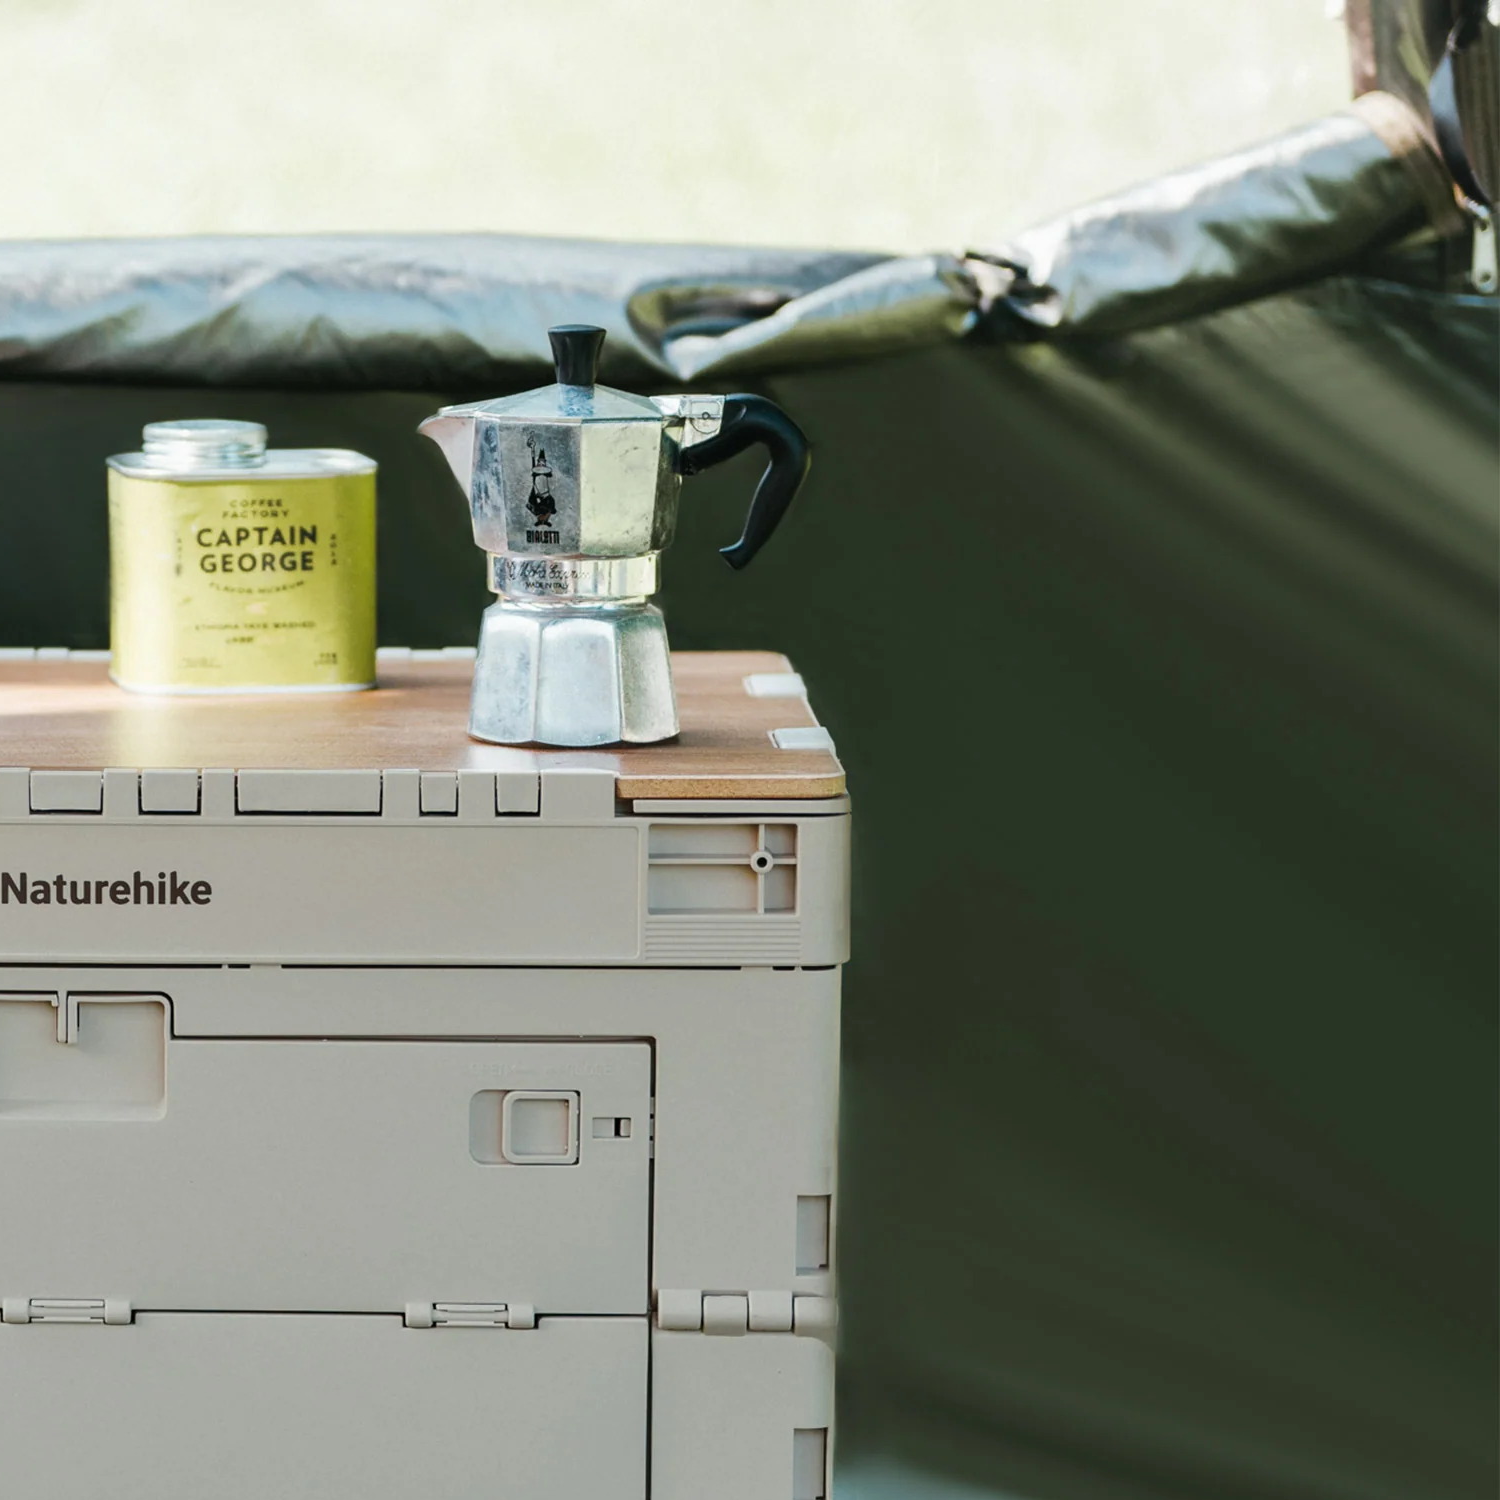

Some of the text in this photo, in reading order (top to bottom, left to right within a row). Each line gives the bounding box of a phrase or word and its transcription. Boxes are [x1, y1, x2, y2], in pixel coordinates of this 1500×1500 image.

[229, 499, 283, 508] COFFEE
[222, 509, 289, 518] FACTORY
[196, 524, 318, 547] CAPTAIN
[526, 530, 560, 544] BIALETTI
[200, 551, 314, 573] GEORGE
[1, 870, 213, 905] Naturehike
